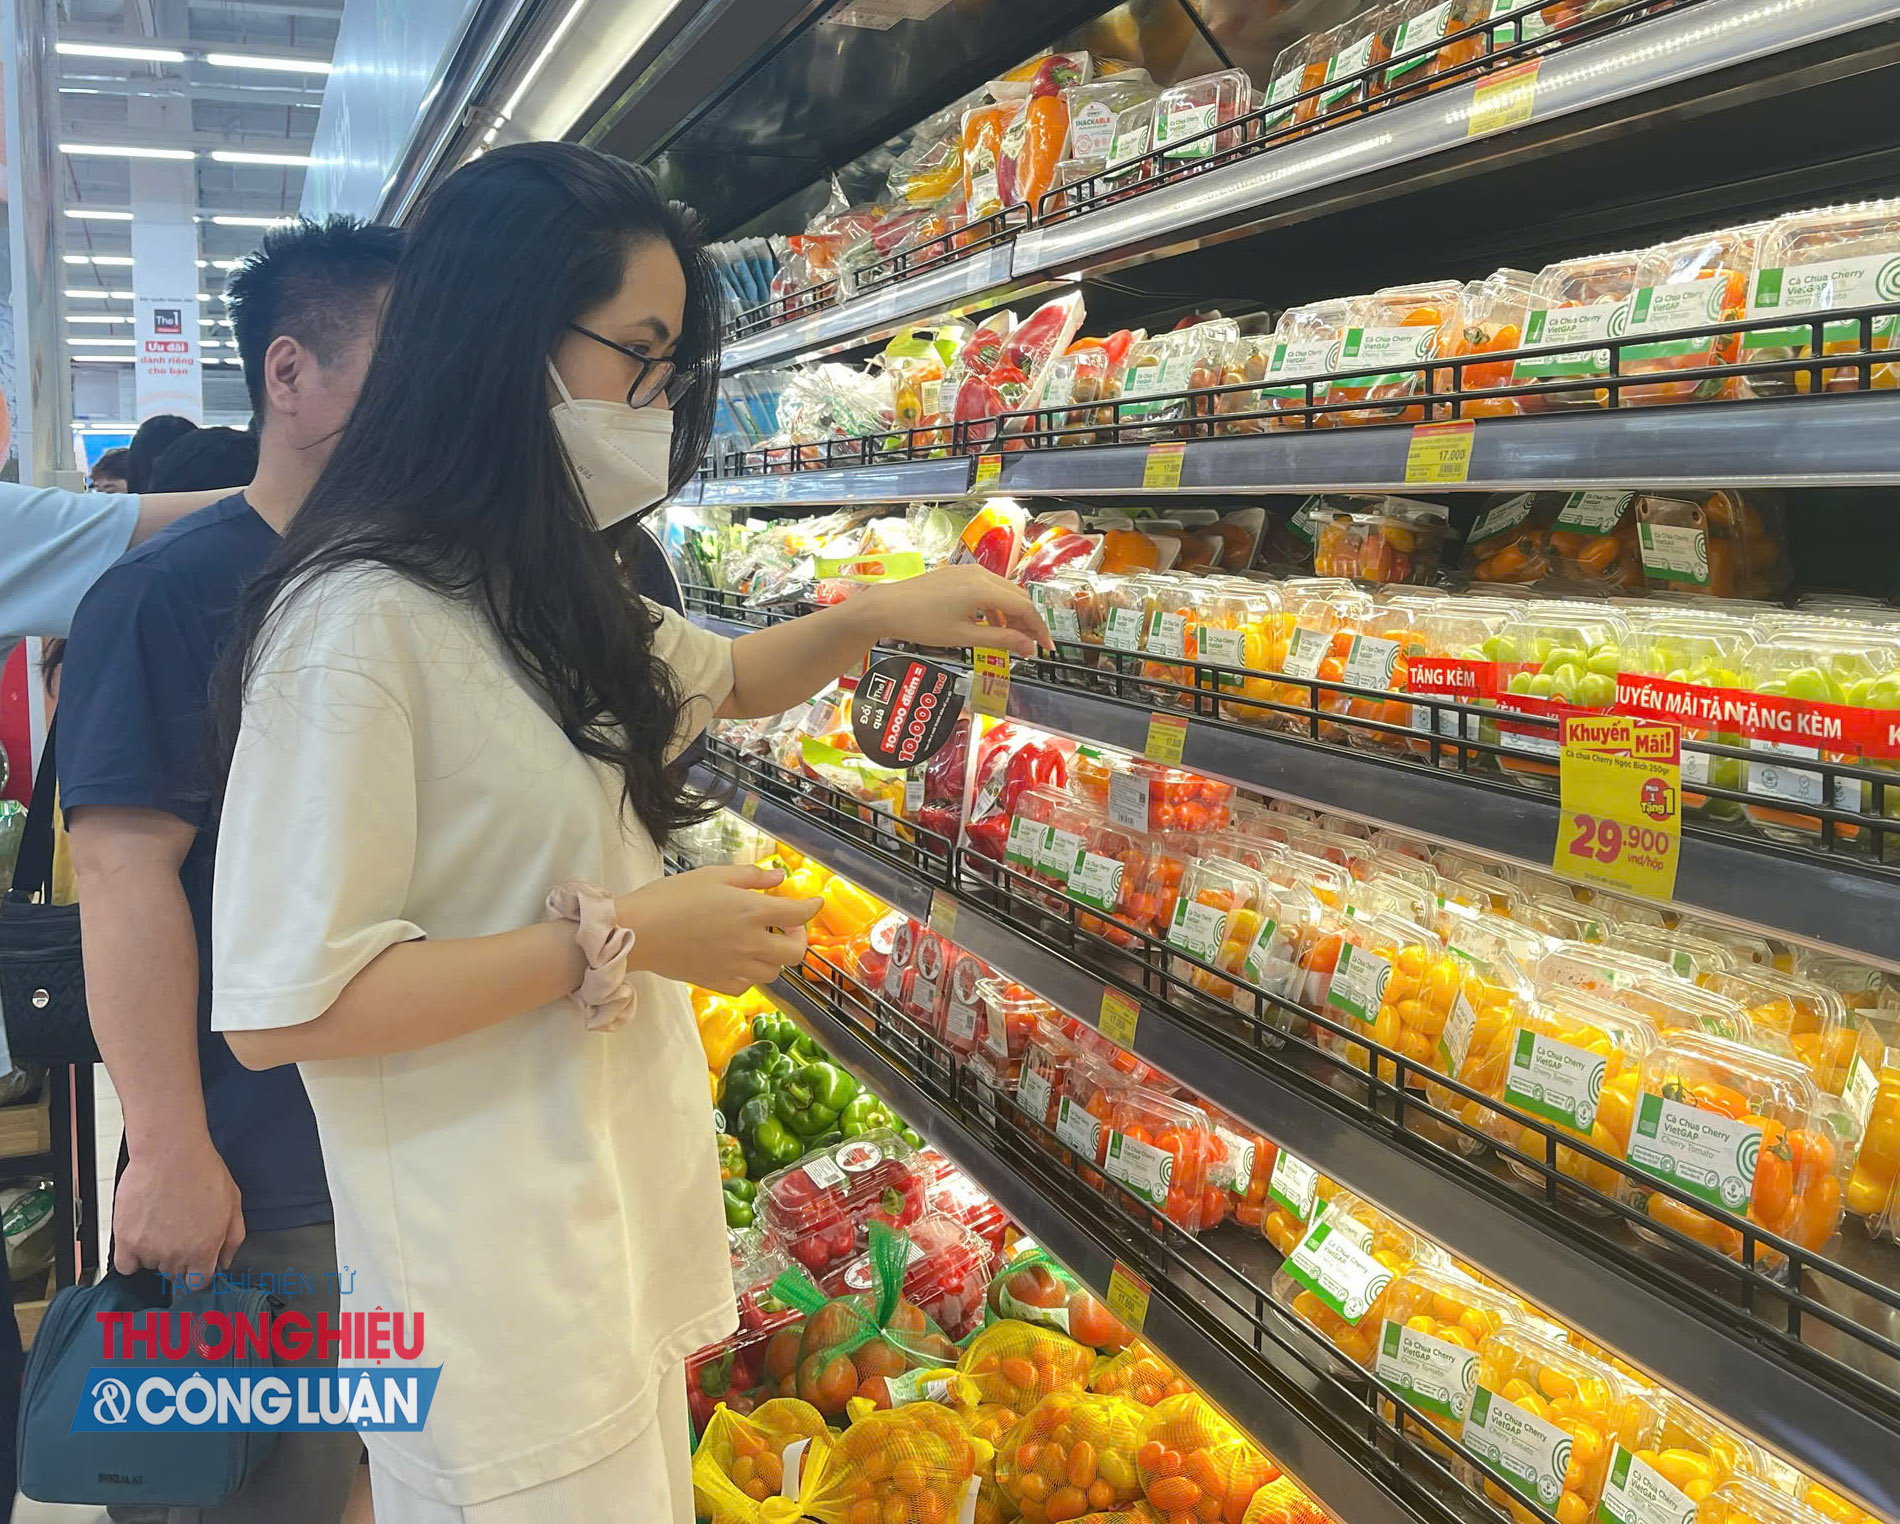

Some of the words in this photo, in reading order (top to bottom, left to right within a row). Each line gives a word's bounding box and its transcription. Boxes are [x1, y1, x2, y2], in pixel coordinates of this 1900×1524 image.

[1076, 117, 1111, 126] SNACKABLE
[1788, 276, 1801, 286] Cà
[1804, 274, 1828, 284] Chua
[1831, 269, 1865, 281] Cherry
[1548, 324, 1576, 333] VietGAP
[1410, 664, 1443, 690] TẶNG
[1446, 669, 1476, 688] KÈM
[860, 704, 872, 724] Đổi
[873, 708, 884, 730] quà
[886, 707, 906, 749] 10.000
[901, 676, 920, 707] điểm
[899, 692, 937, 762] 10.000
[932, 672, 948, 694] vnd
[1665, 692, 1698, 715] MÃI
[1700, 696, 1741, 726] TẶN
[1738, 701, 1792, 733] TẶNG
[1797, 712, 1842, 739] KÈM
[1569, 720, 1630, 745] Khuyến
[1635, 732, 1672, 754] Mãi!
[1566, 750, 1574, 758] Cà
[1576, 752, 1590, 761] chua
[1592, 754, 1613, 766] Cherry
[1614, 757, 1632, 770] Ngọc
[1633, 760, 1648, 771] Bích
[1649, 763, 1670, 776] 250gr
[1646, 784, 1659, 792] Mua
[1650, 793, 1655, 802] 1
[1640, 801, 1664, 815] Tặng
[1662, 788, 1676, 815] 1
[1628, 853, 1664, 872] vnd/hộp
[1536, 1056, 1562, 1070] VietGAP
[1537, 1046, 1546, 1056] Cà
[1546, 1050, 1563, 1062] Chua
[1564, 1056, 1586, 1070] Cherry
[1664, 1124, 1699, 1140] VietGAP
[1666, 1113, 1677, 1123] Cà
[1679, 1118, 1700, 1130] Chua
[1702, 1124, 1730, 1142] Cherry
[1661, 1136, 1686, 1152] Cherry
[1688, 1142, 1714, 1160] Tomato
[1324, 1245, 1347, 1265] VietGAP
[1402, 1346, 1430, 1361] VietGAP
[1404, 1338, 1413, 1346] Cà
[1414, 1342, 1432, 1354] Chua
[1432, 1348, 1456, 1364] Cherry
[1401, 1356, 1420, 1370] Cherry
[1422, 1364, 1445, 1378] Tomato
[1490, 1416, 1522, 1436] VietGAP
[1493, 1406, 1503, 1418] Cà
[1504, 1412, 1523, 1428] Chua
[1524, 1423, 1548, 1442] Cherry
[1488, 1426, 1510, 1444] Cherry
[1511, 1437, 1534, 1456] Tomato
[1630, 1478, 1657, 1502] VietGAP
[1632, 1470, 1642, 1481] Cà
[1642, 1478, 1658, 1494] Chua
[1658, 1490, 1678, 1510] Cherry
